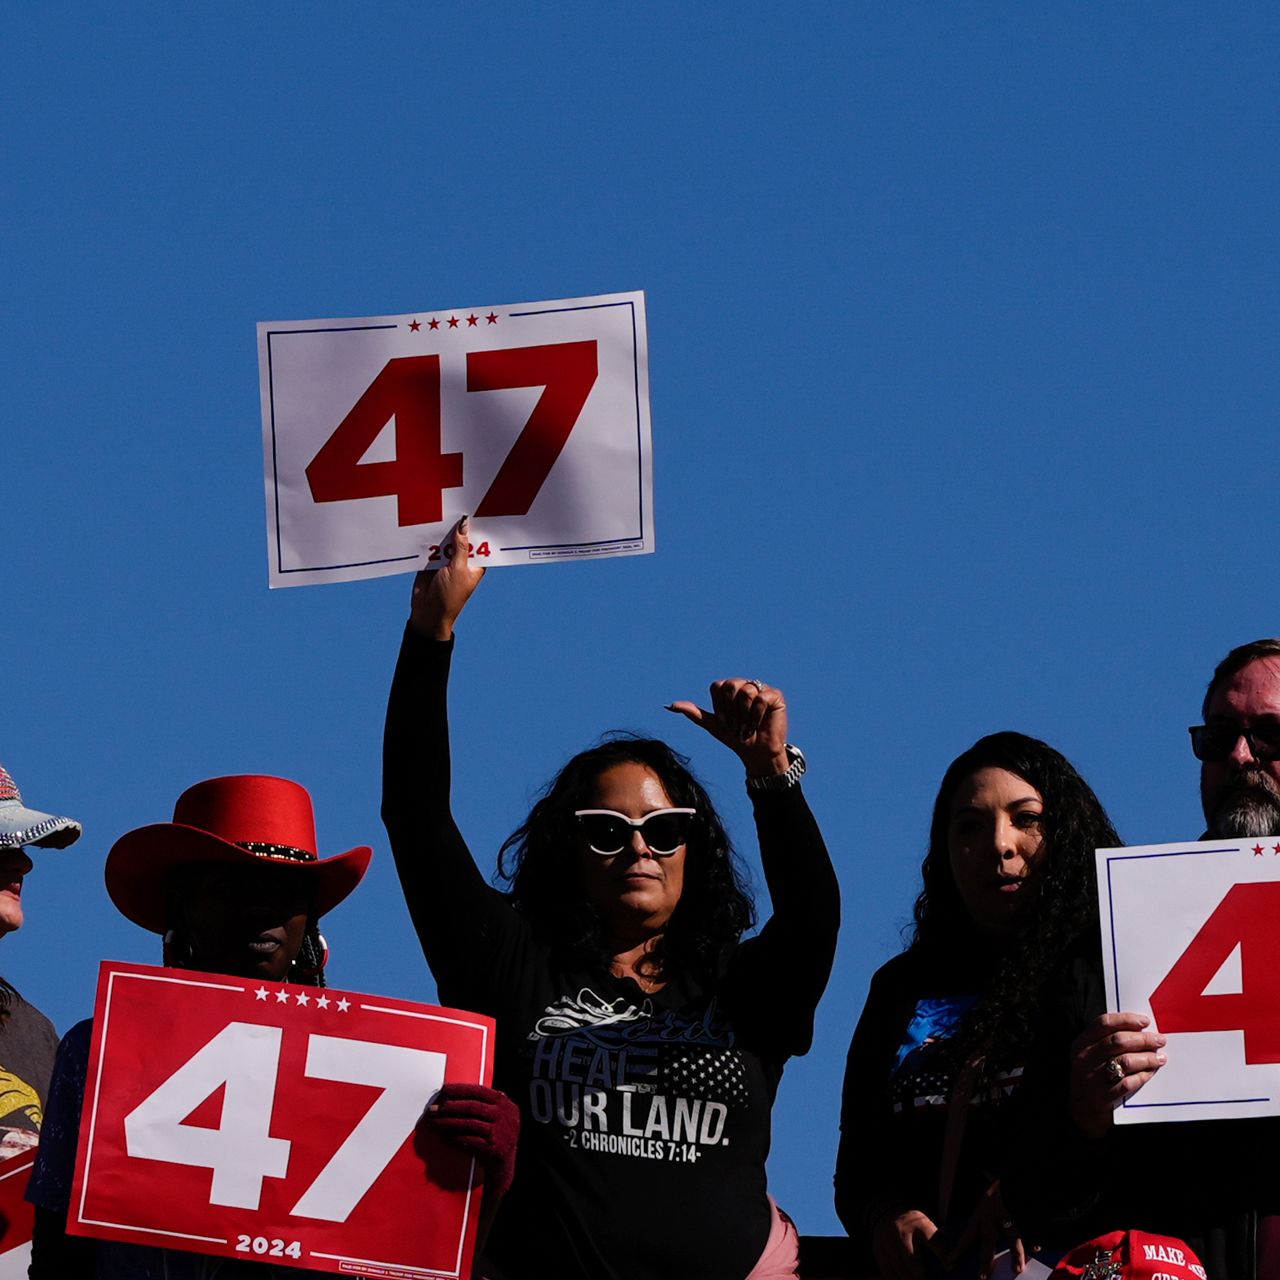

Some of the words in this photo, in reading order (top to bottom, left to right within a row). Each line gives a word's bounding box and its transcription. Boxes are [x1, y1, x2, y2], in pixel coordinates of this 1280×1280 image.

[305, 340, 599, 527] 47
[533, 1038, 637, 1093] HEAL
[124, 1021, 447, 1223] 47
[528, 1078, 609, 1132] OUR
[623, 1091, 730, 1147] LAND.
[581, 1130, 664, 1161] CHRONICLES
[235, 1234, 302, 1259] 2024
[1142, 1244, 1186, 1267] MAKE
